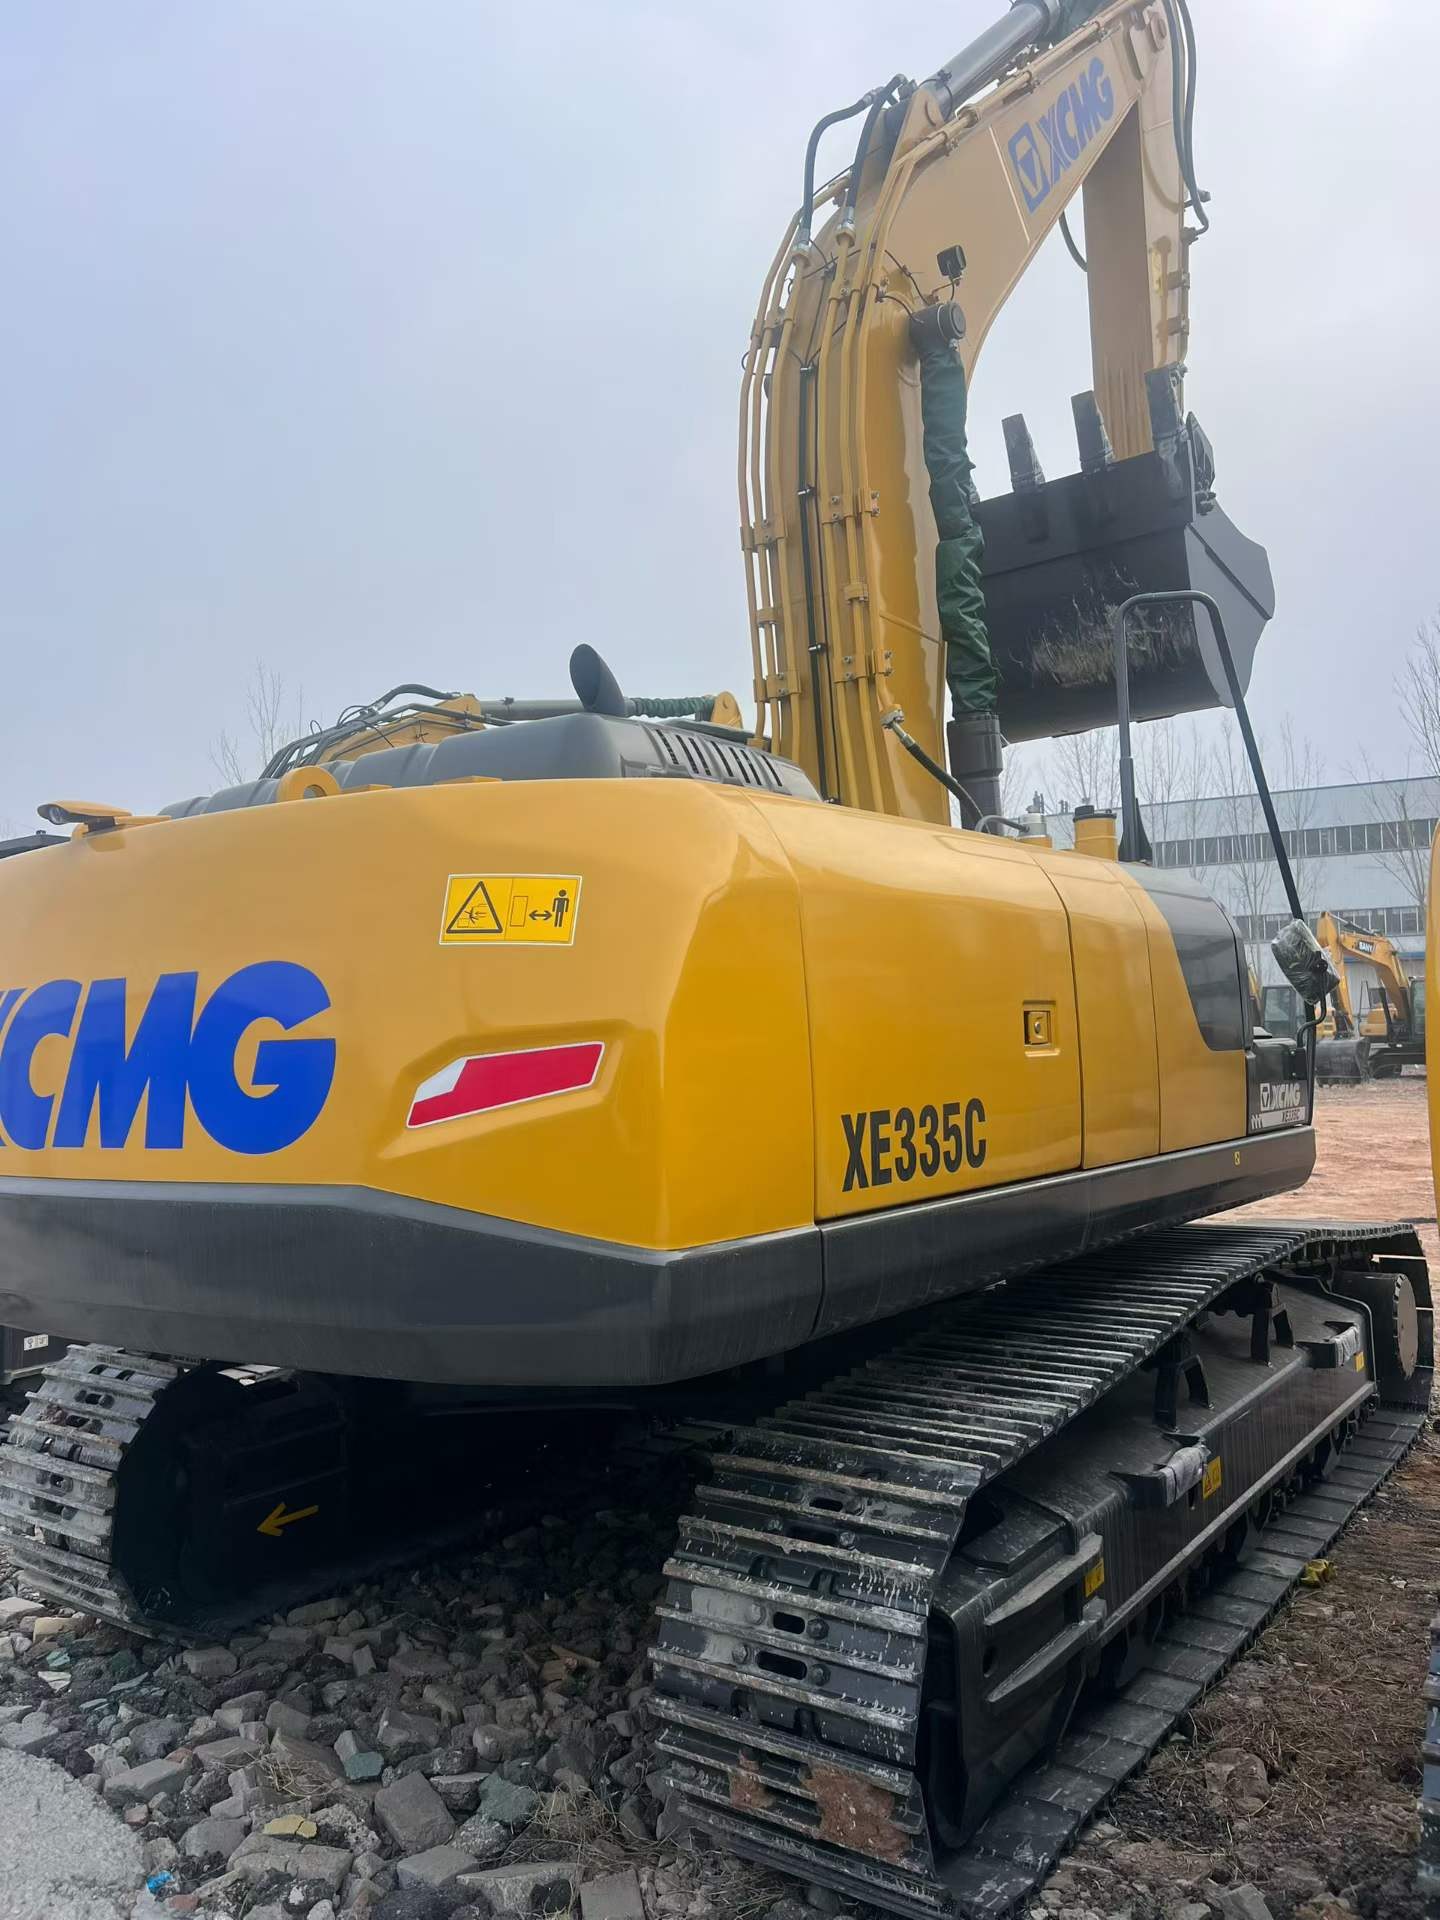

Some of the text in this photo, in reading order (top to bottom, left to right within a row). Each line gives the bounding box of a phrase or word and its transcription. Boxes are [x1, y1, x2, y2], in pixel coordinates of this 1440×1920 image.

[1036, 56, 1114, 188] XCMG
[1270, 1083, 1301, 1110] XCMG
[841, 1098, 986, 1192] XE335C
